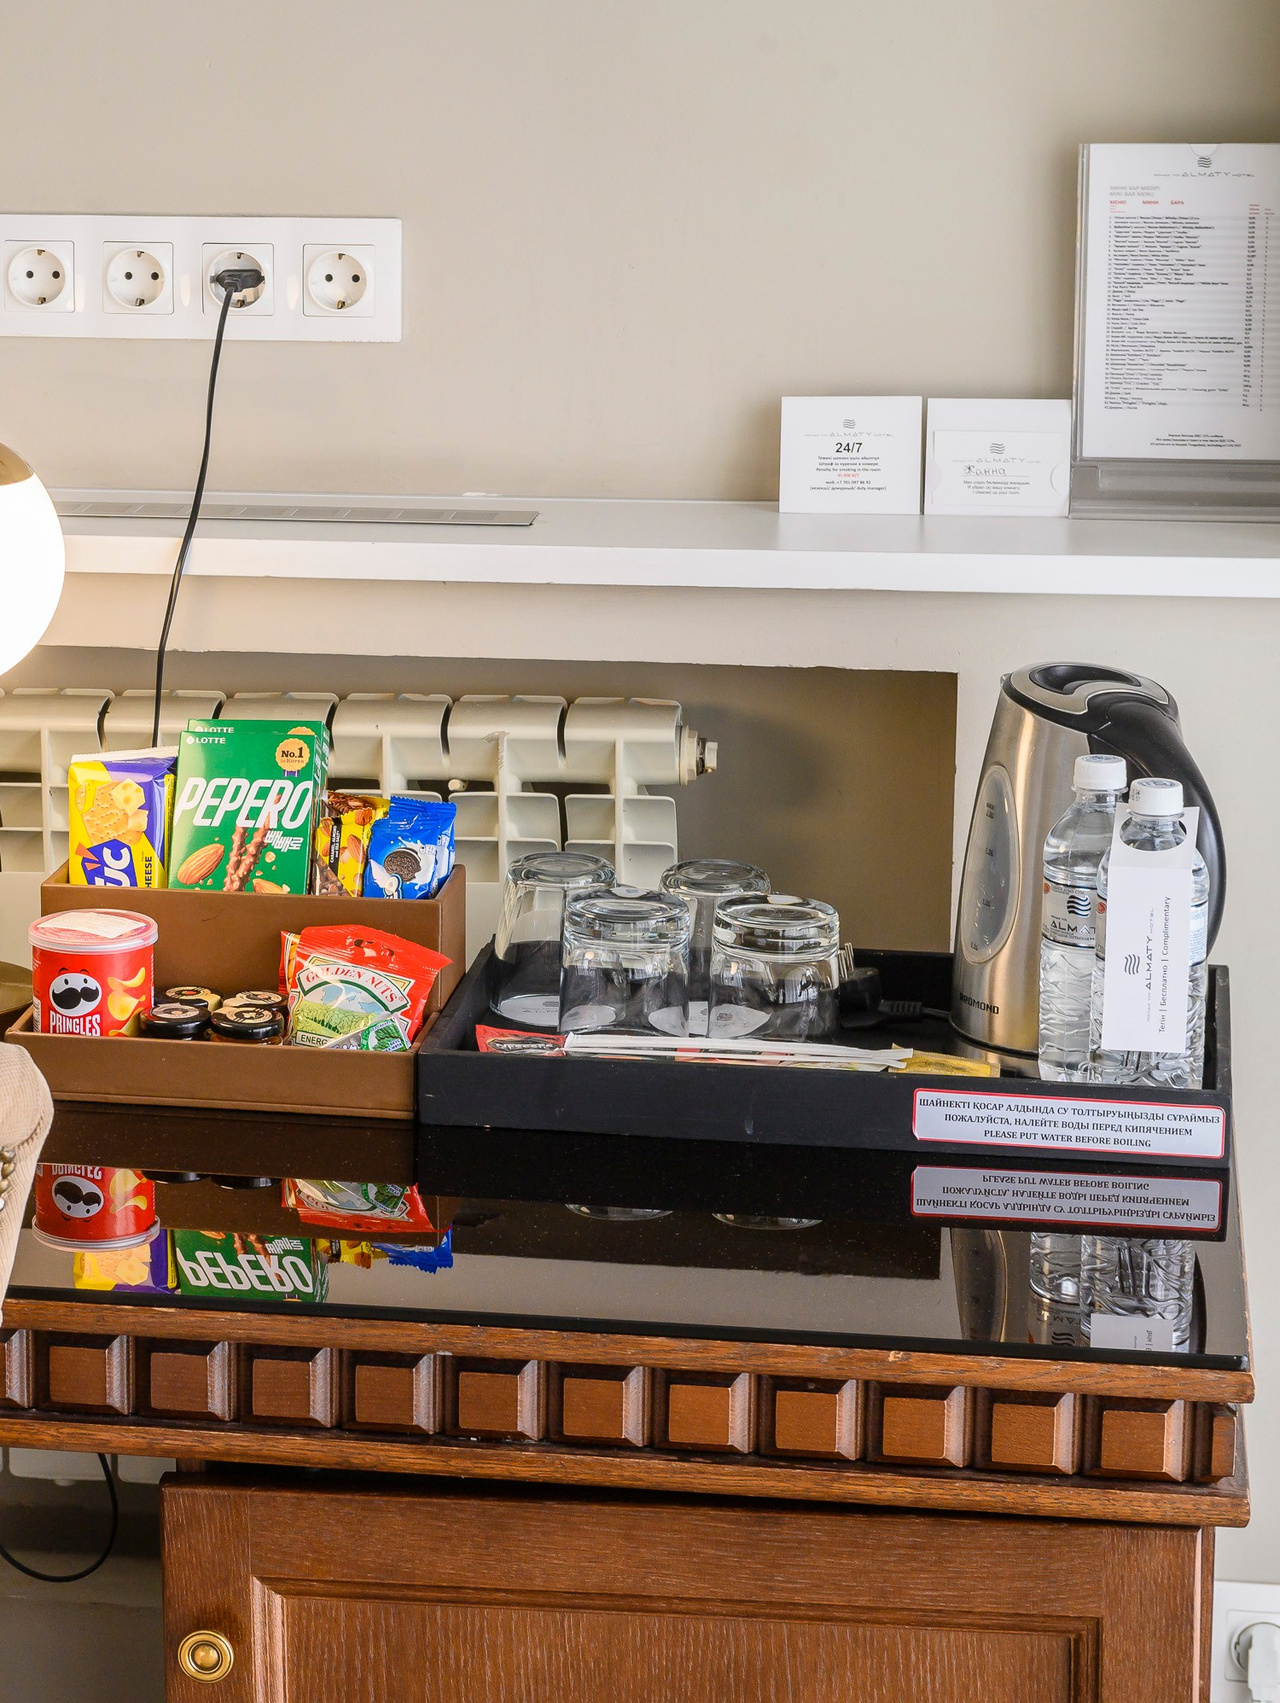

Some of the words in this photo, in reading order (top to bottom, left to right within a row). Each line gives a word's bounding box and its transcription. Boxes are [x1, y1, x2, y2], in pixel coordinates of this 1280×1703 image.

[835, 442, 863, 453] 24/7
[963, 464, 1007, 477] Жанна
[195, 736, 226, 745] LOTTE
[204, 726, 235, 734] LOTTE
[280, 746, 304, 759] No.1
[173, 776, 313, 830] PEPERO
[264, 830, 304, 852] 빼빼로
[94, 846, 131, 887] UC
[144, 856, 153, 888] HEESE
[1050, 920, 1096, 934] ALMAT
[1161, 896, 1171, 956] Complimentary
[1145, 935, 1153, 991] ALMATY
[305, 966, 366, 983] GOLDEN
[365, 975, 398, 1003] NUTS
[1159, 965, 1168, 1006] Бесплатно
[959, 991, 1000, 1015] REDMOND
[49, 1009, 101, 1037] PRINGLES
[1158, 1014, 1166, 1033] Тегін
[300, 1034, 327, 1046] ENERG
[919, 1097, 971, 1109] ШАЙНЕКТІ
[972, 1102, 1004, 1111] ҚОСАР
[1006, 1104, 1055, 1115] АЛДЫНДА
[1057, 1107, 1069, 1115] СУ
[1071, 1107, 1164, 1121] ТОЛТЫРУЫҢЫЗДЫ
[1166, 1113, 1220, 1124] СҰРАЙМЫЗ
[944, 1113, 1012, 1126] ПОЖАЛУЙСТА,
[1014, 1117, 1059, 1128] НАЛЕЙТЕ
[1061, 1121, 1090, 1130] ВОДЫ
[1092, 1123, 1123, 1133] ПЕРЕД
[1125, 1125, 1193, 1136] КИПЯЧЕНИЕМ
[984, 1129, 1018, 1139] PLEASE
[1020, 1132, 1039, 1140] PUT
[1041, 1133, 1073, 1143] WATER
[1075, 1136, 1111, 1145] BEFORE
[1113, 1138, 1151, 1147] BOILING
